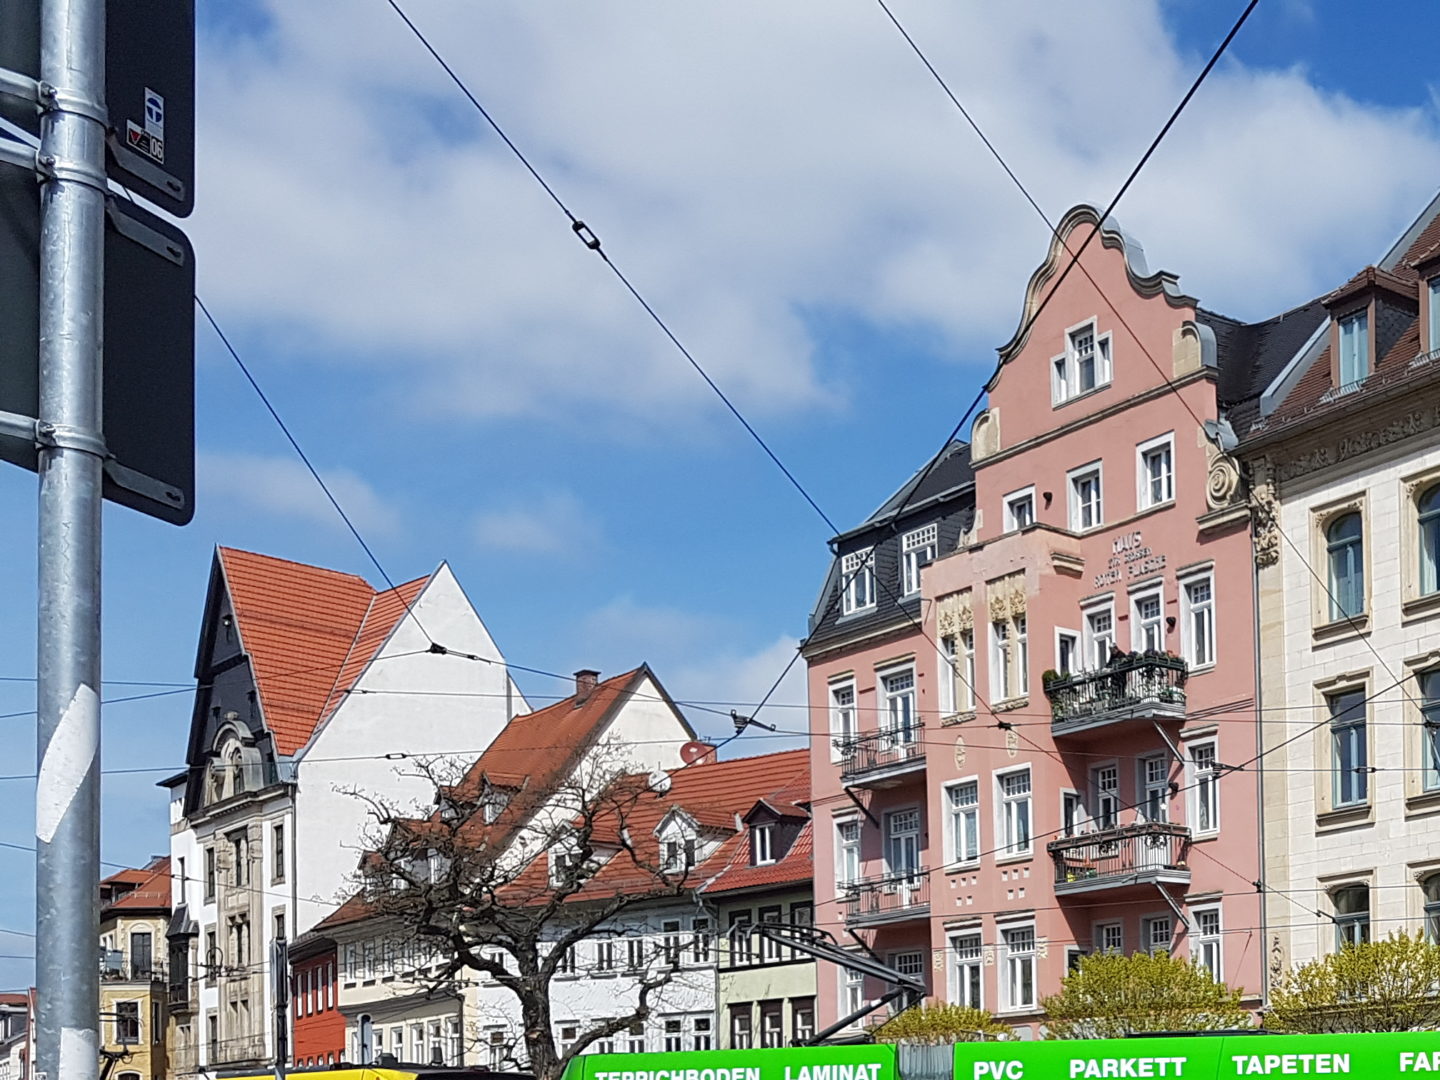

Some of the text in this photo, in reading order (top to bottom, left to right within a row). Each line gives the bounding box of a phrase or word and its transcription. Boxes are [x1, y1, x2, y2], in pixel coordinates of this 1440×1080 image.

[973, 1060, 1023, 1080] PVC
[1069, 1057, 1187, 1079] PARKETT
[1232, 1053, 1350, 1075] TAPETEN
